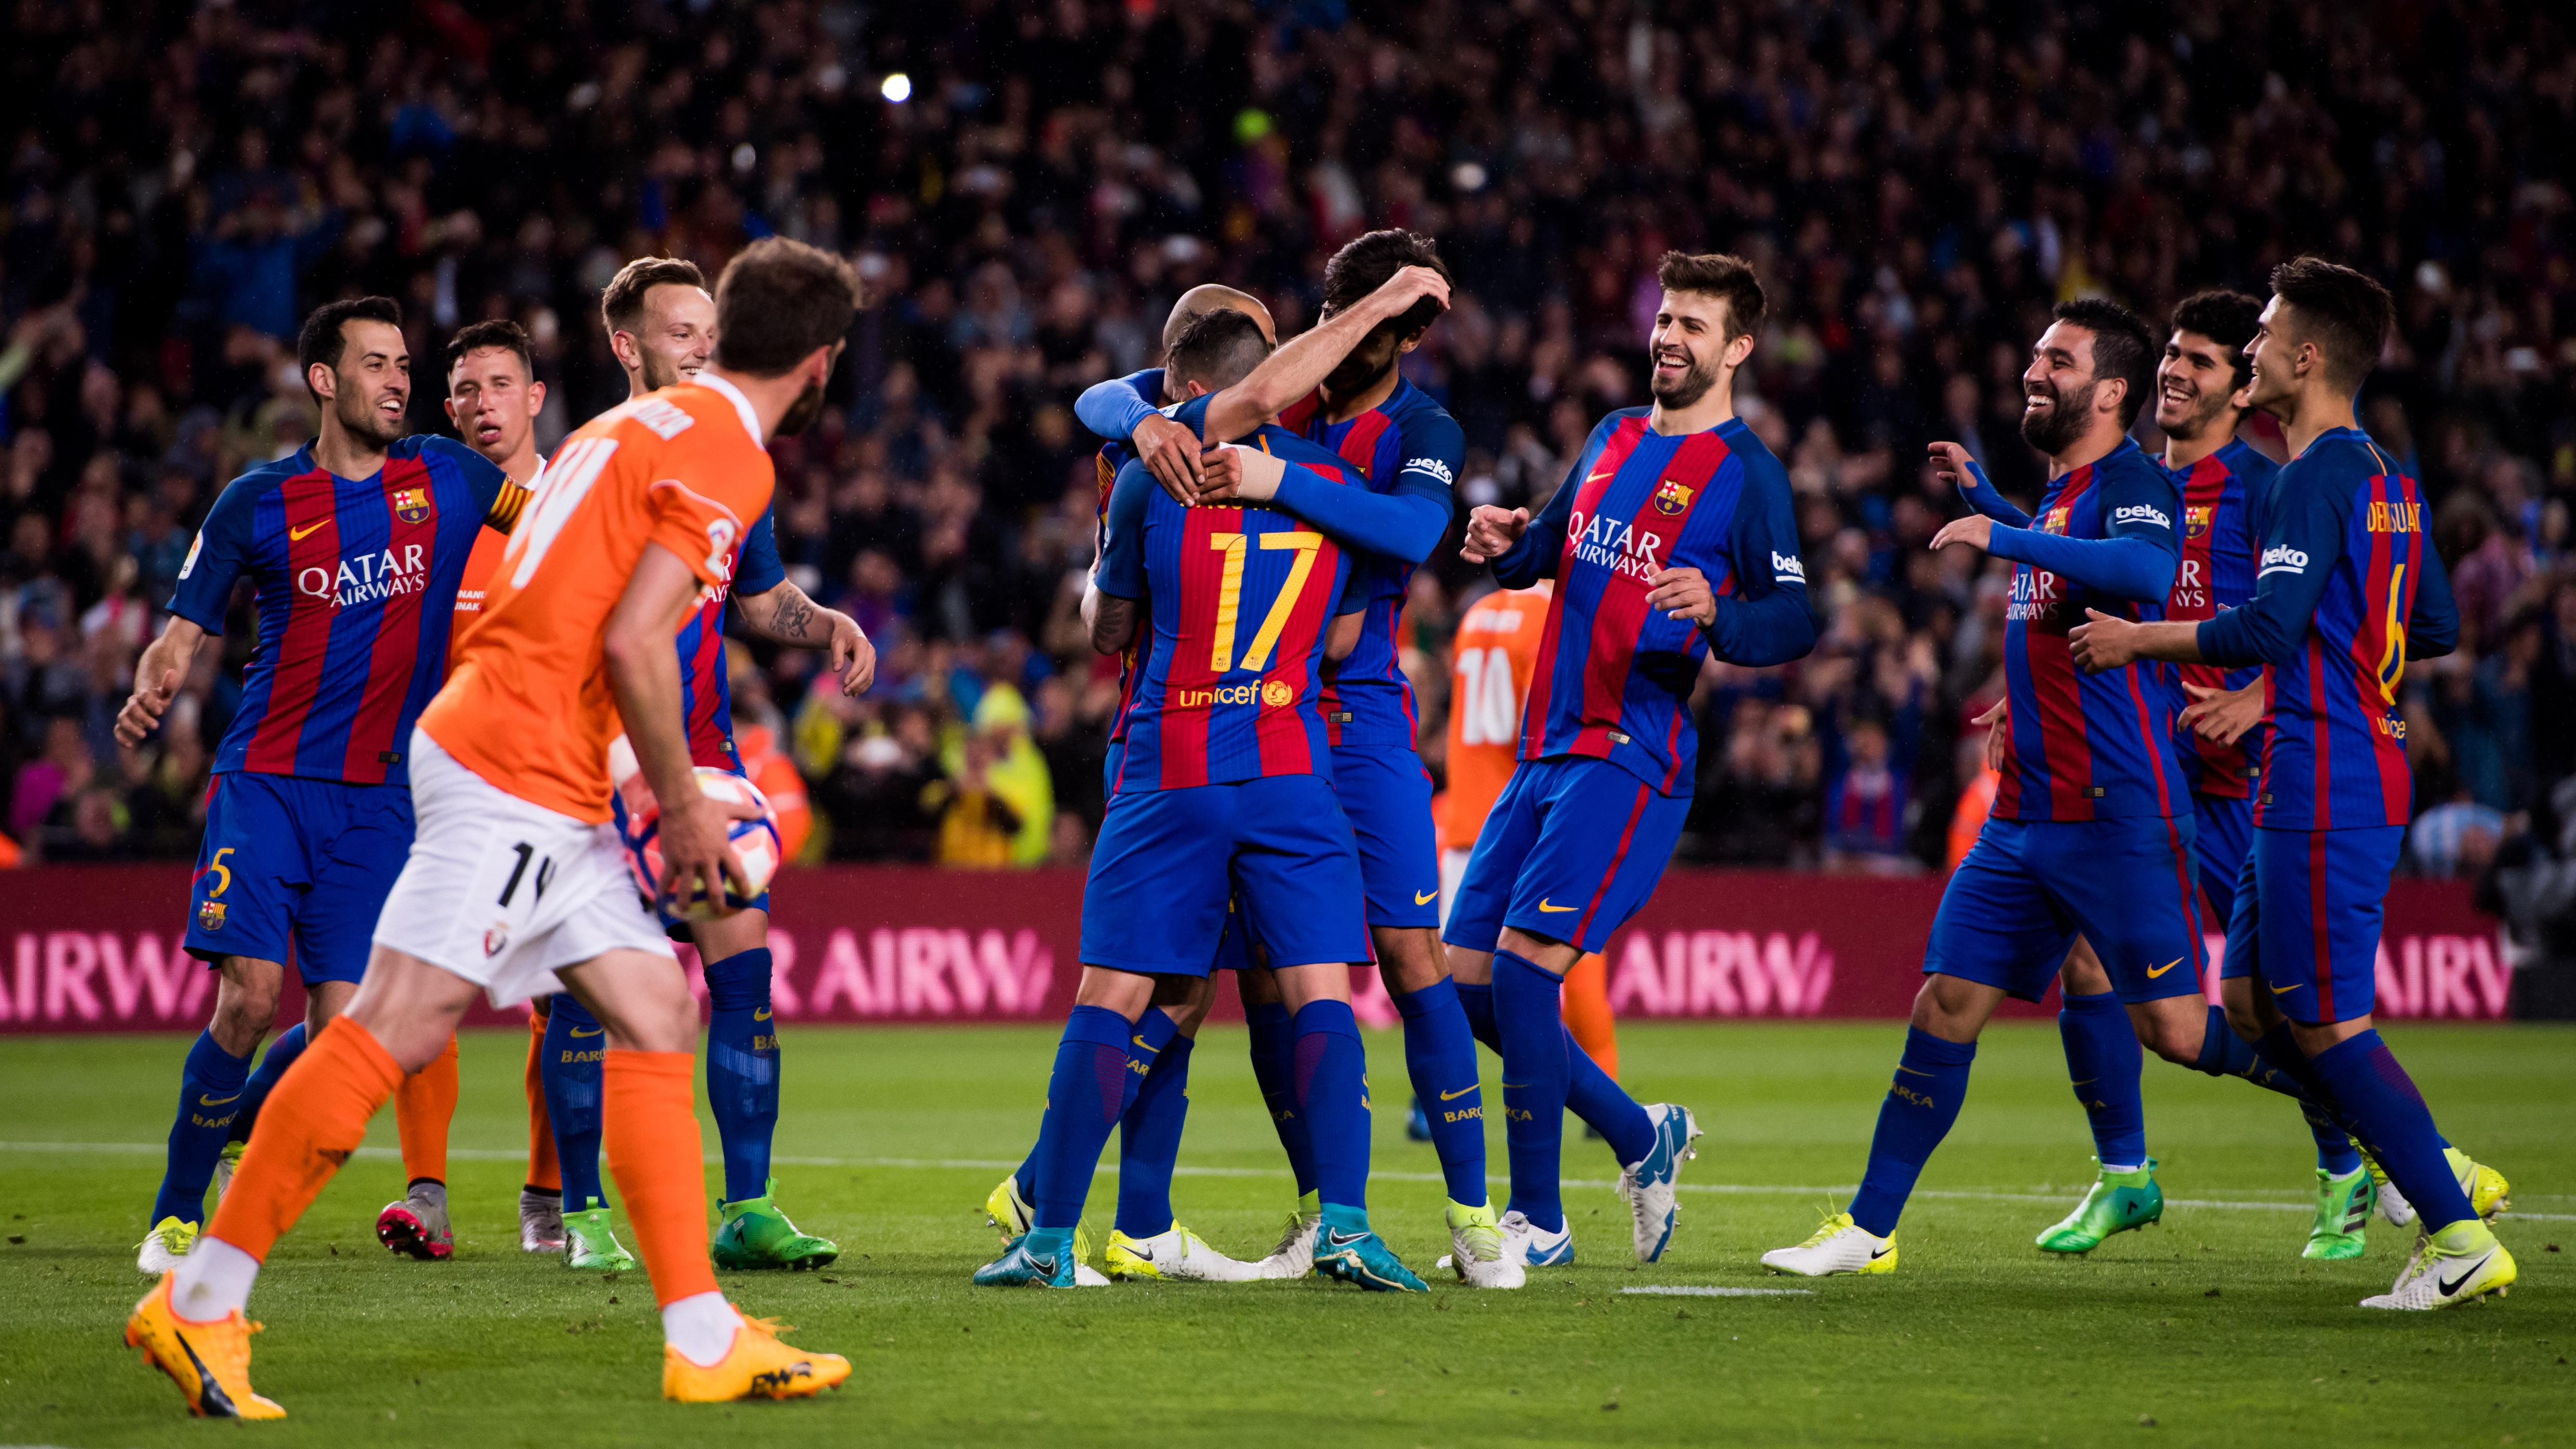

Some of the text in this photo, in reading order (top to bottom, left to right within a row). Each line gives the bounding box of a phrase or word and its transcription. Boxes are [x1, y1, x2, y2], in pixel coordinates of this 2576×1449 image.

[2116, 504, 2170, 525] beko
[1568, 511, 1661, 564] QATAR
[2261, 544, 2309, 567] beko
[298, 544, 426, 599] QATAR
[1570, 541, 1650, 581] AIRWAYS
[1772, 551, 1804, 578] bek
[330, 573, 425, 608] AIRWAYS
[1211, 532, 1324, 672] 17
[2008, 571, 2058, 601] ATAR
[2377, 563, 2405, 706] 6
[1180, 679, 1261, 707] unicef
[1456, 647, 1516, 746] 10
[209, 848, 235, 898] 5
[0, 931, 210, 1022] IRW
[1891, 1081, 1934, 1109] ARÇA
[1444, 1106, 1482, 1123] BARÇ
